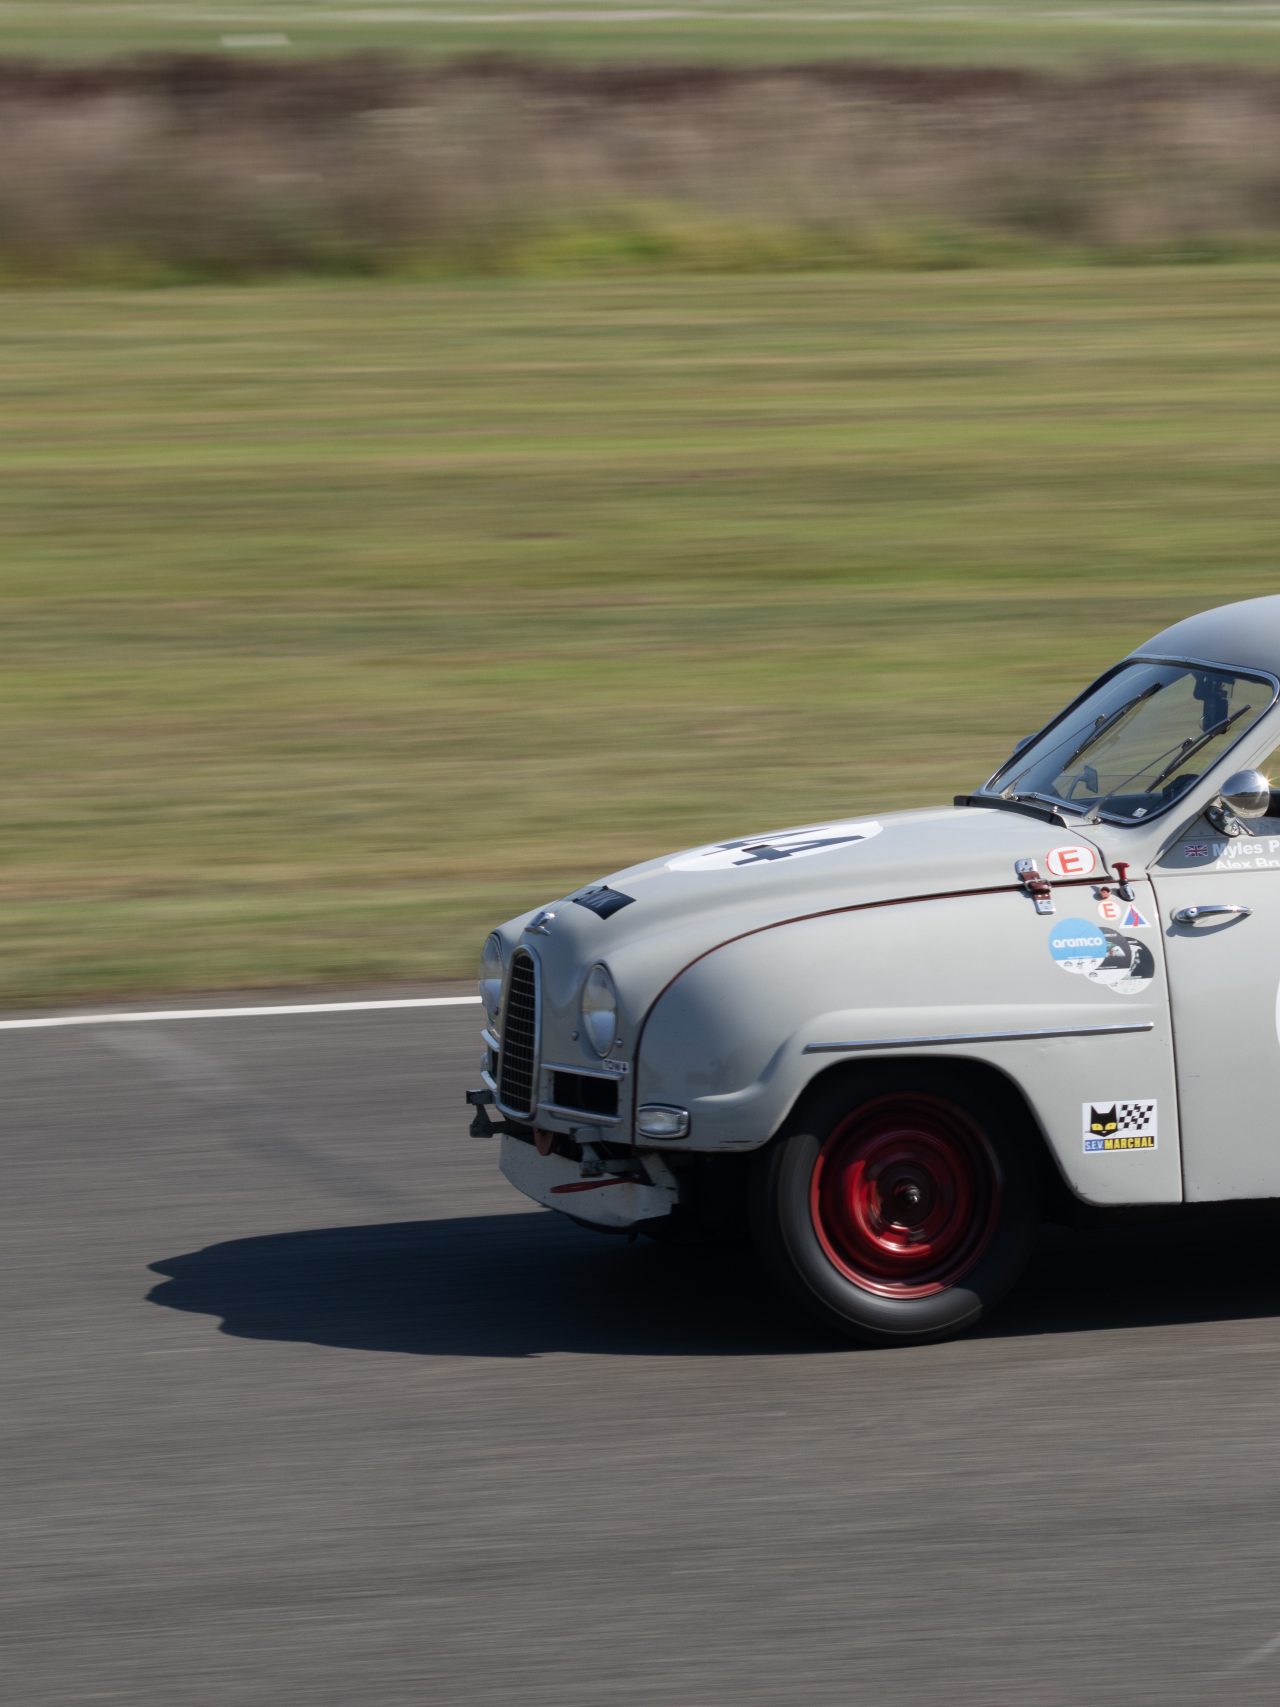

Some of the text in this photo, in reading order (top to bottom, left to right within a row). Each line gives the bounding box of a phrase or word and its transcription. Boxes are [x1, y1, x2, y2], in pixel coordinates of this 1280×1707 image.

[1211, 841, 1263, 858] Myles
[1058, 849, 1083, 874] E
[1215, 860, 1251, 870] Alex
[1103, 903, 1117, 918] E
[1052, 936, 1103, 949] aramco
[1104, 1136, 1154, 1150] MARCHAL
